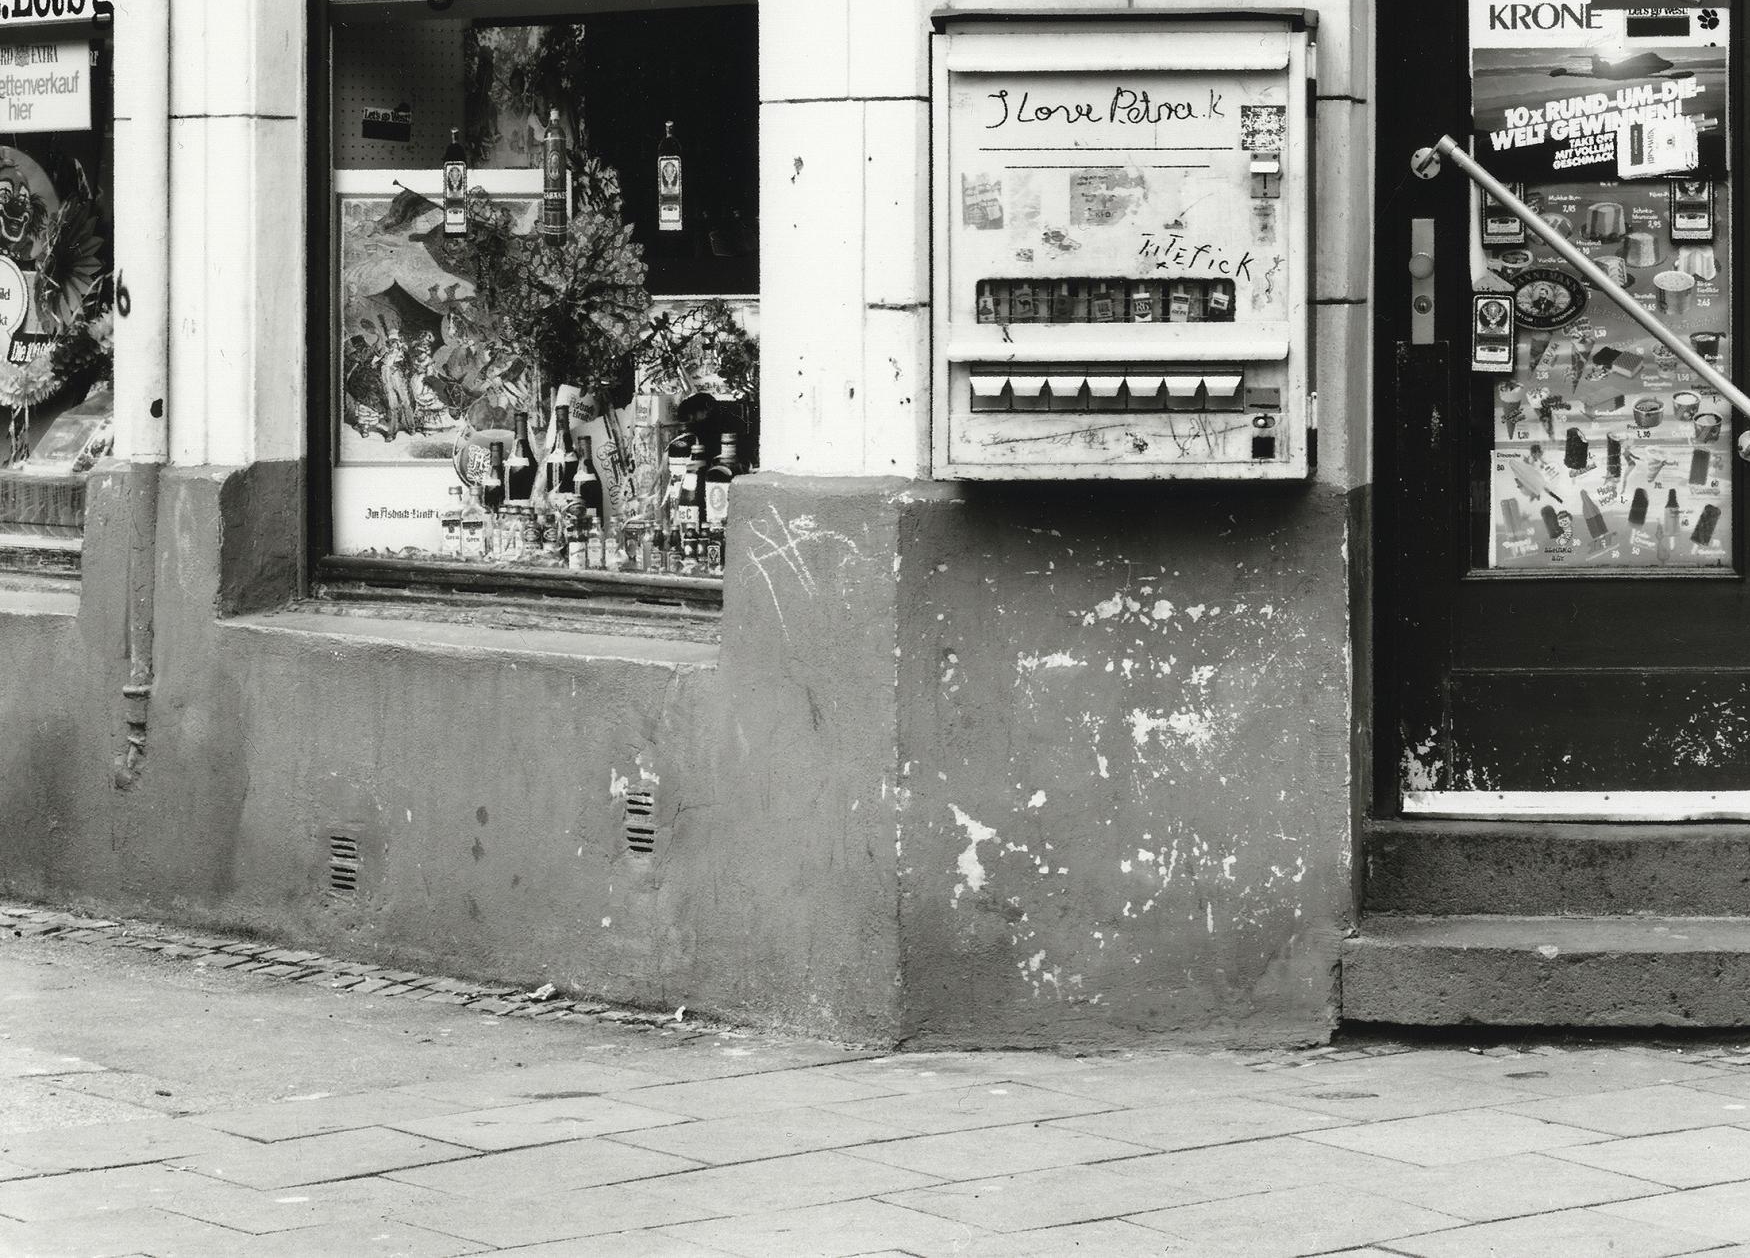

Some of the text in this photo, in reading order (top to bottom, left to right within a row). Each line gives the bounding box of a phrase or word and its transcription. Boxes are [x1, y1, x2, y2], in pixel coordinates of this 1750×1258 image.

[1489, 2, 1603, 30] KRONE
[0, 70, 80, 96] ettenverkauf
[8, 98, 34, 121] hier
[1017, 92, 1102, 123] Love
[1490, 123, 1548, 151] WELT
[1550, 99, 1682, 141] GEWINNEN!
[1555, 142, 1615, 160] MIT VOLLEM
[1570, 135, 1595, 149] TAKE
[1553, 153, 1615, 170] GESCHMACK
